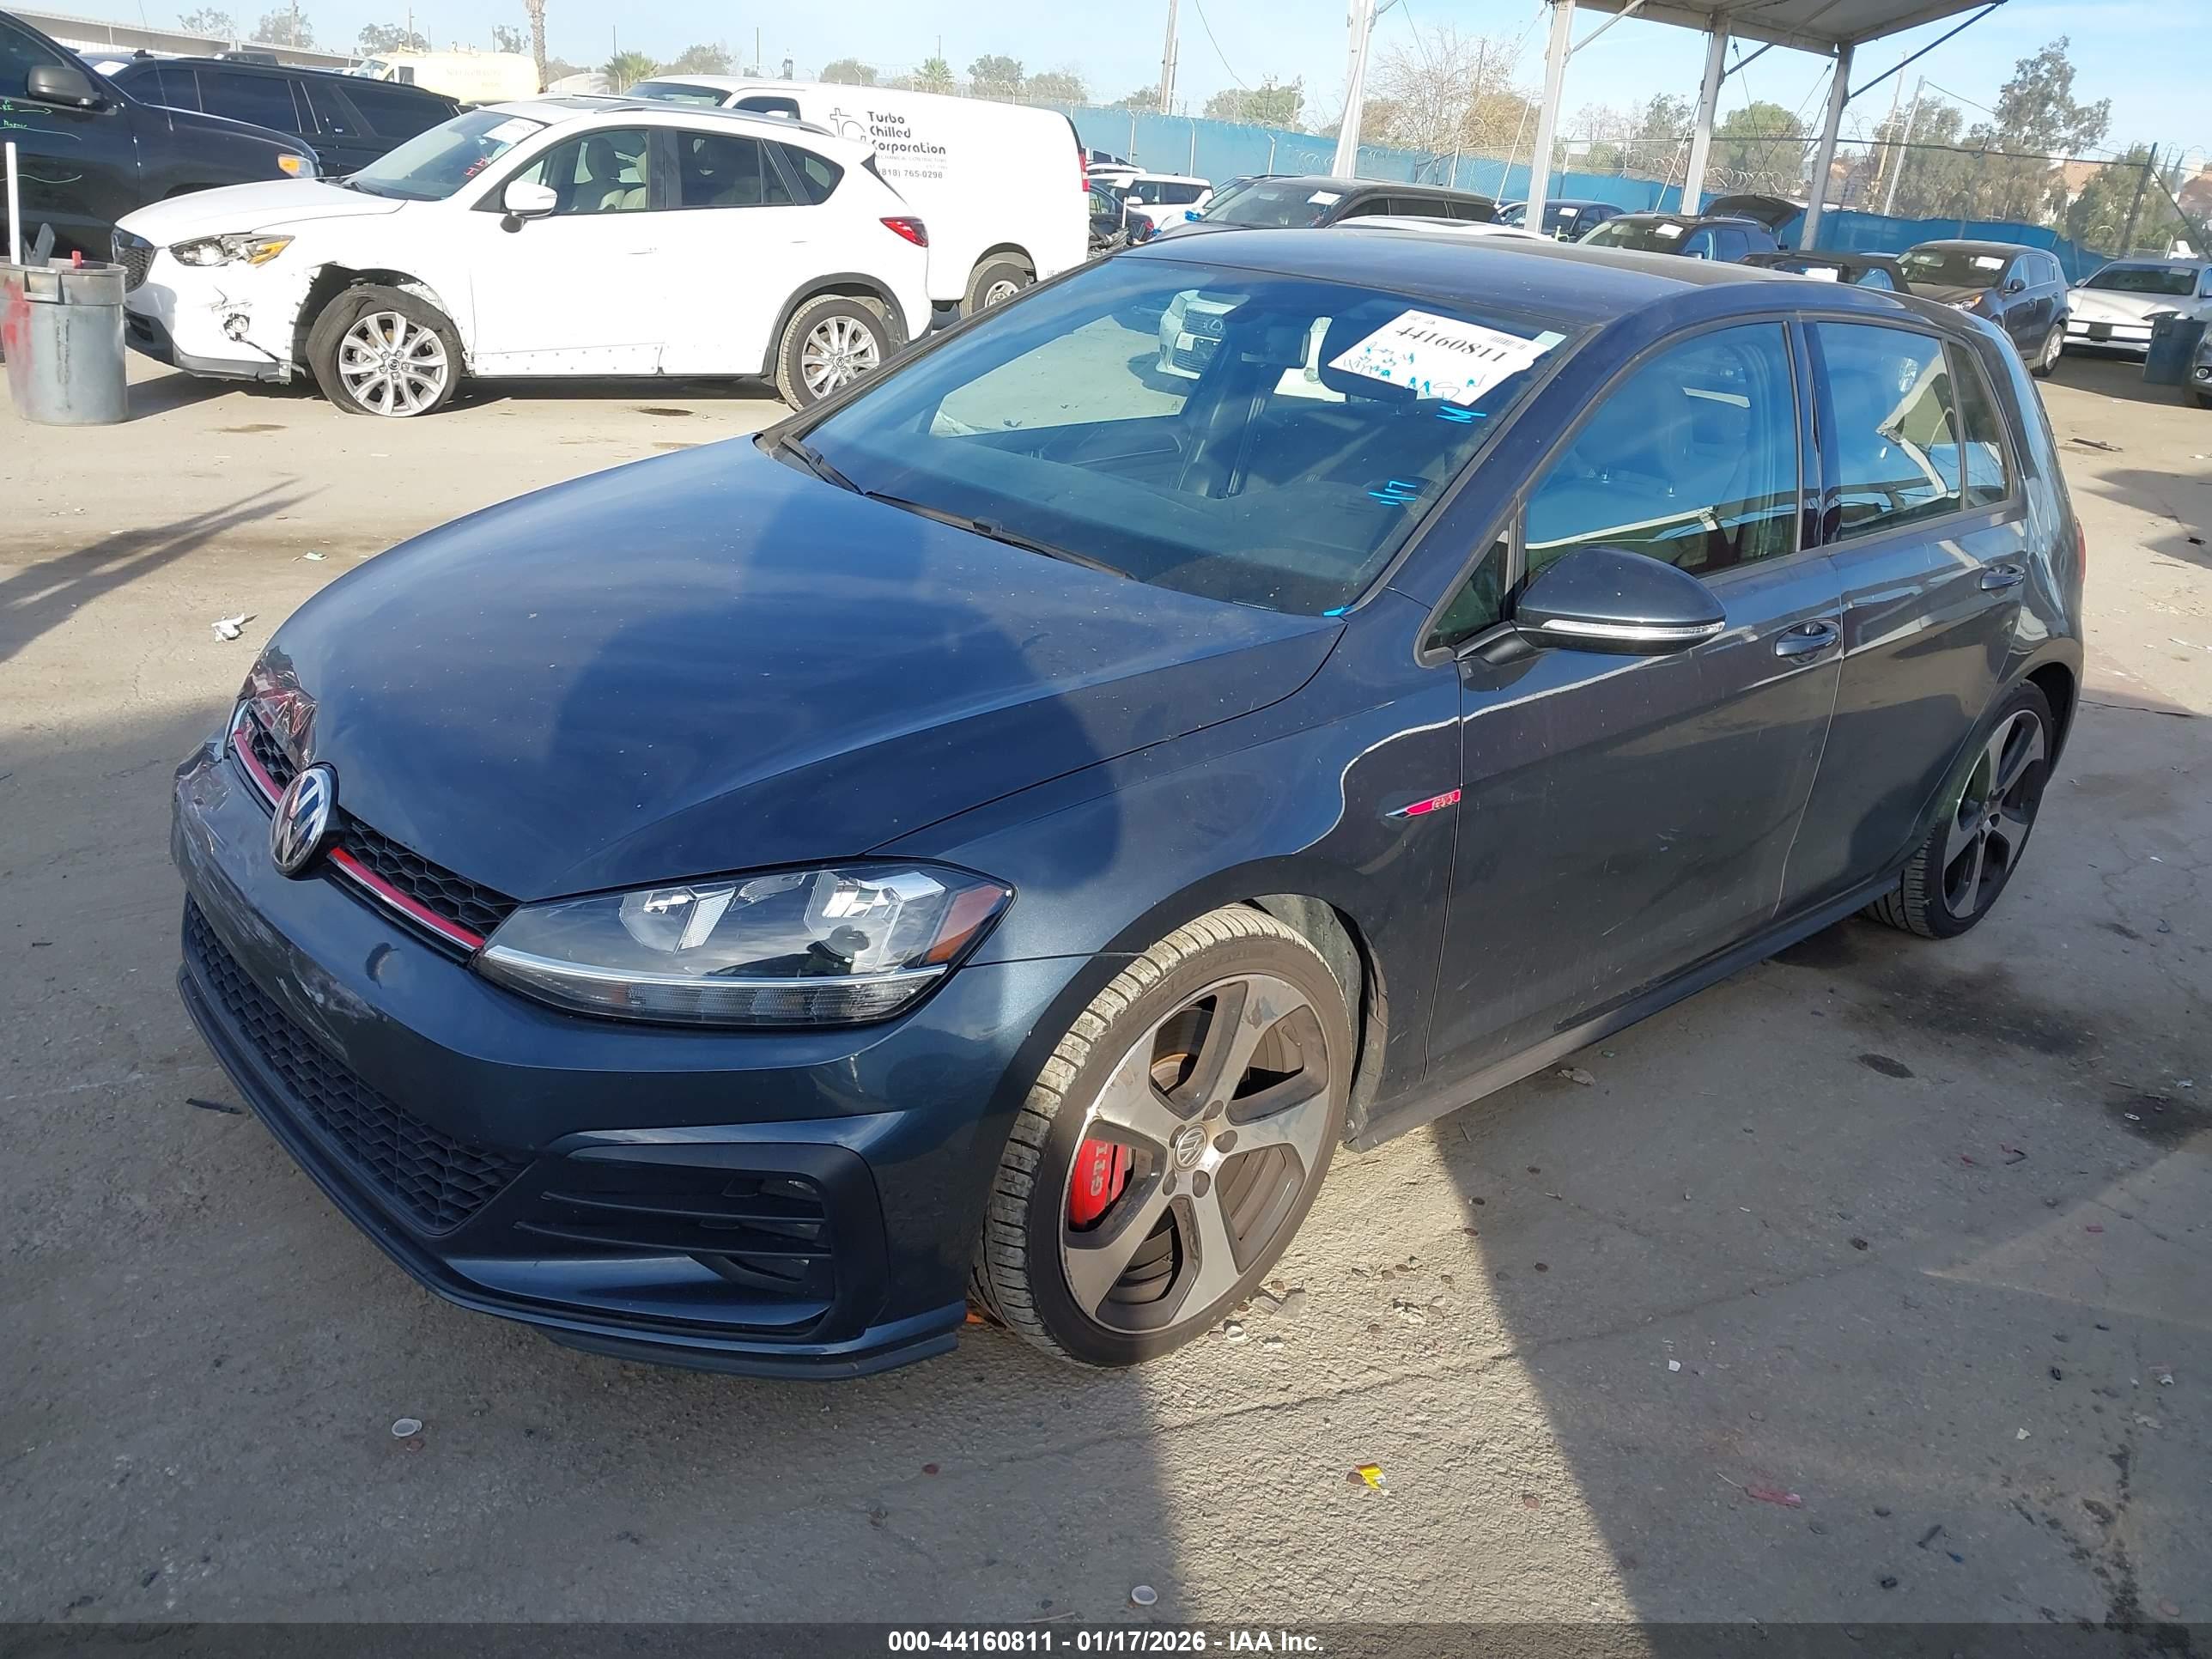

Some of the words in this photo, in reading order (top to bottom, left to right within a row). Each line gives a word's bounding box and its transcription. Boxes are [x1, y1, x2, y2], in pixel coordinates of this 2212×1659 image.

[866, 111, 905, 124] Turbo
[870, 125, 911, 138] Chilled
[872, 139, 946, 155] Corporation
[1395, 325, 1508, 362] 44160811
[1091, 1143, 1108, 1196] GTI
